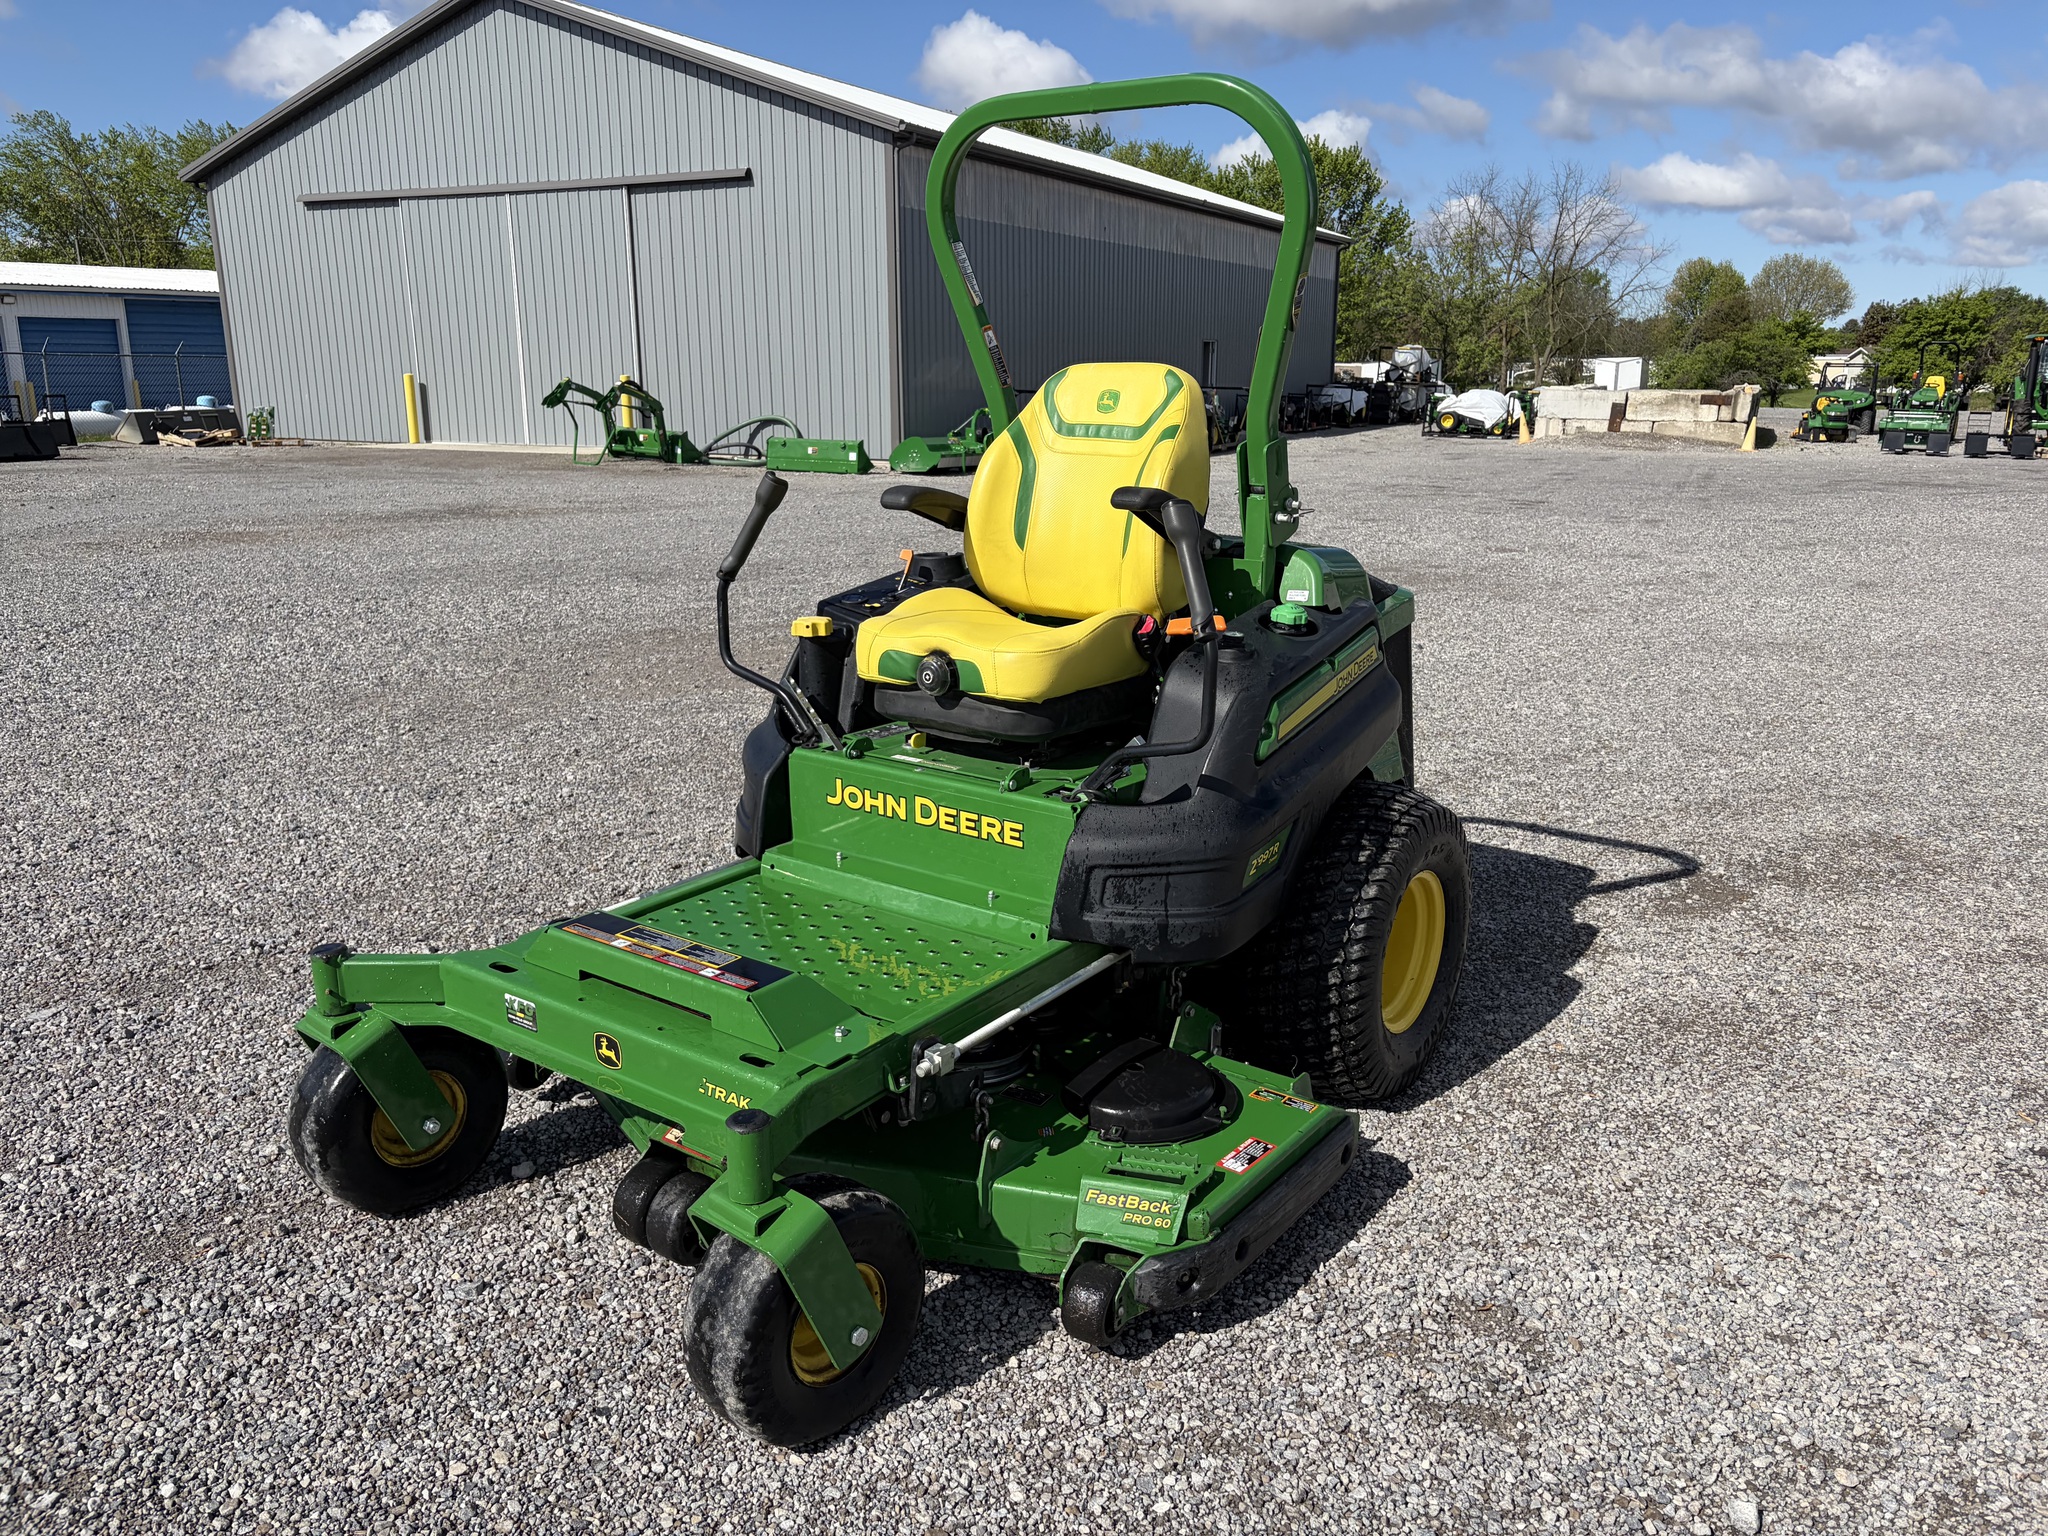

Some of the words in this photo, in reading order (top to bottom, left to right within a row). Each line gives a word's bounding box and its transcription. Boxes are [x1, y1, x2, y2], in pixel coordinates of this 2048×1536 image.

[1333, 667, 1353, 695] JOHN
[1353, 650, 1375, 676] DEERE
[826, 777, 908, 821] JOHN
[913, 794, 1024, 849] DEERE
[507, 996, 535, 1016] KFG
[1085, 1188, 1173, 1215] FastBack
[1122, 1212, 1152, 1226] PRO
[1154, 1217, 1171, 1229] 60
